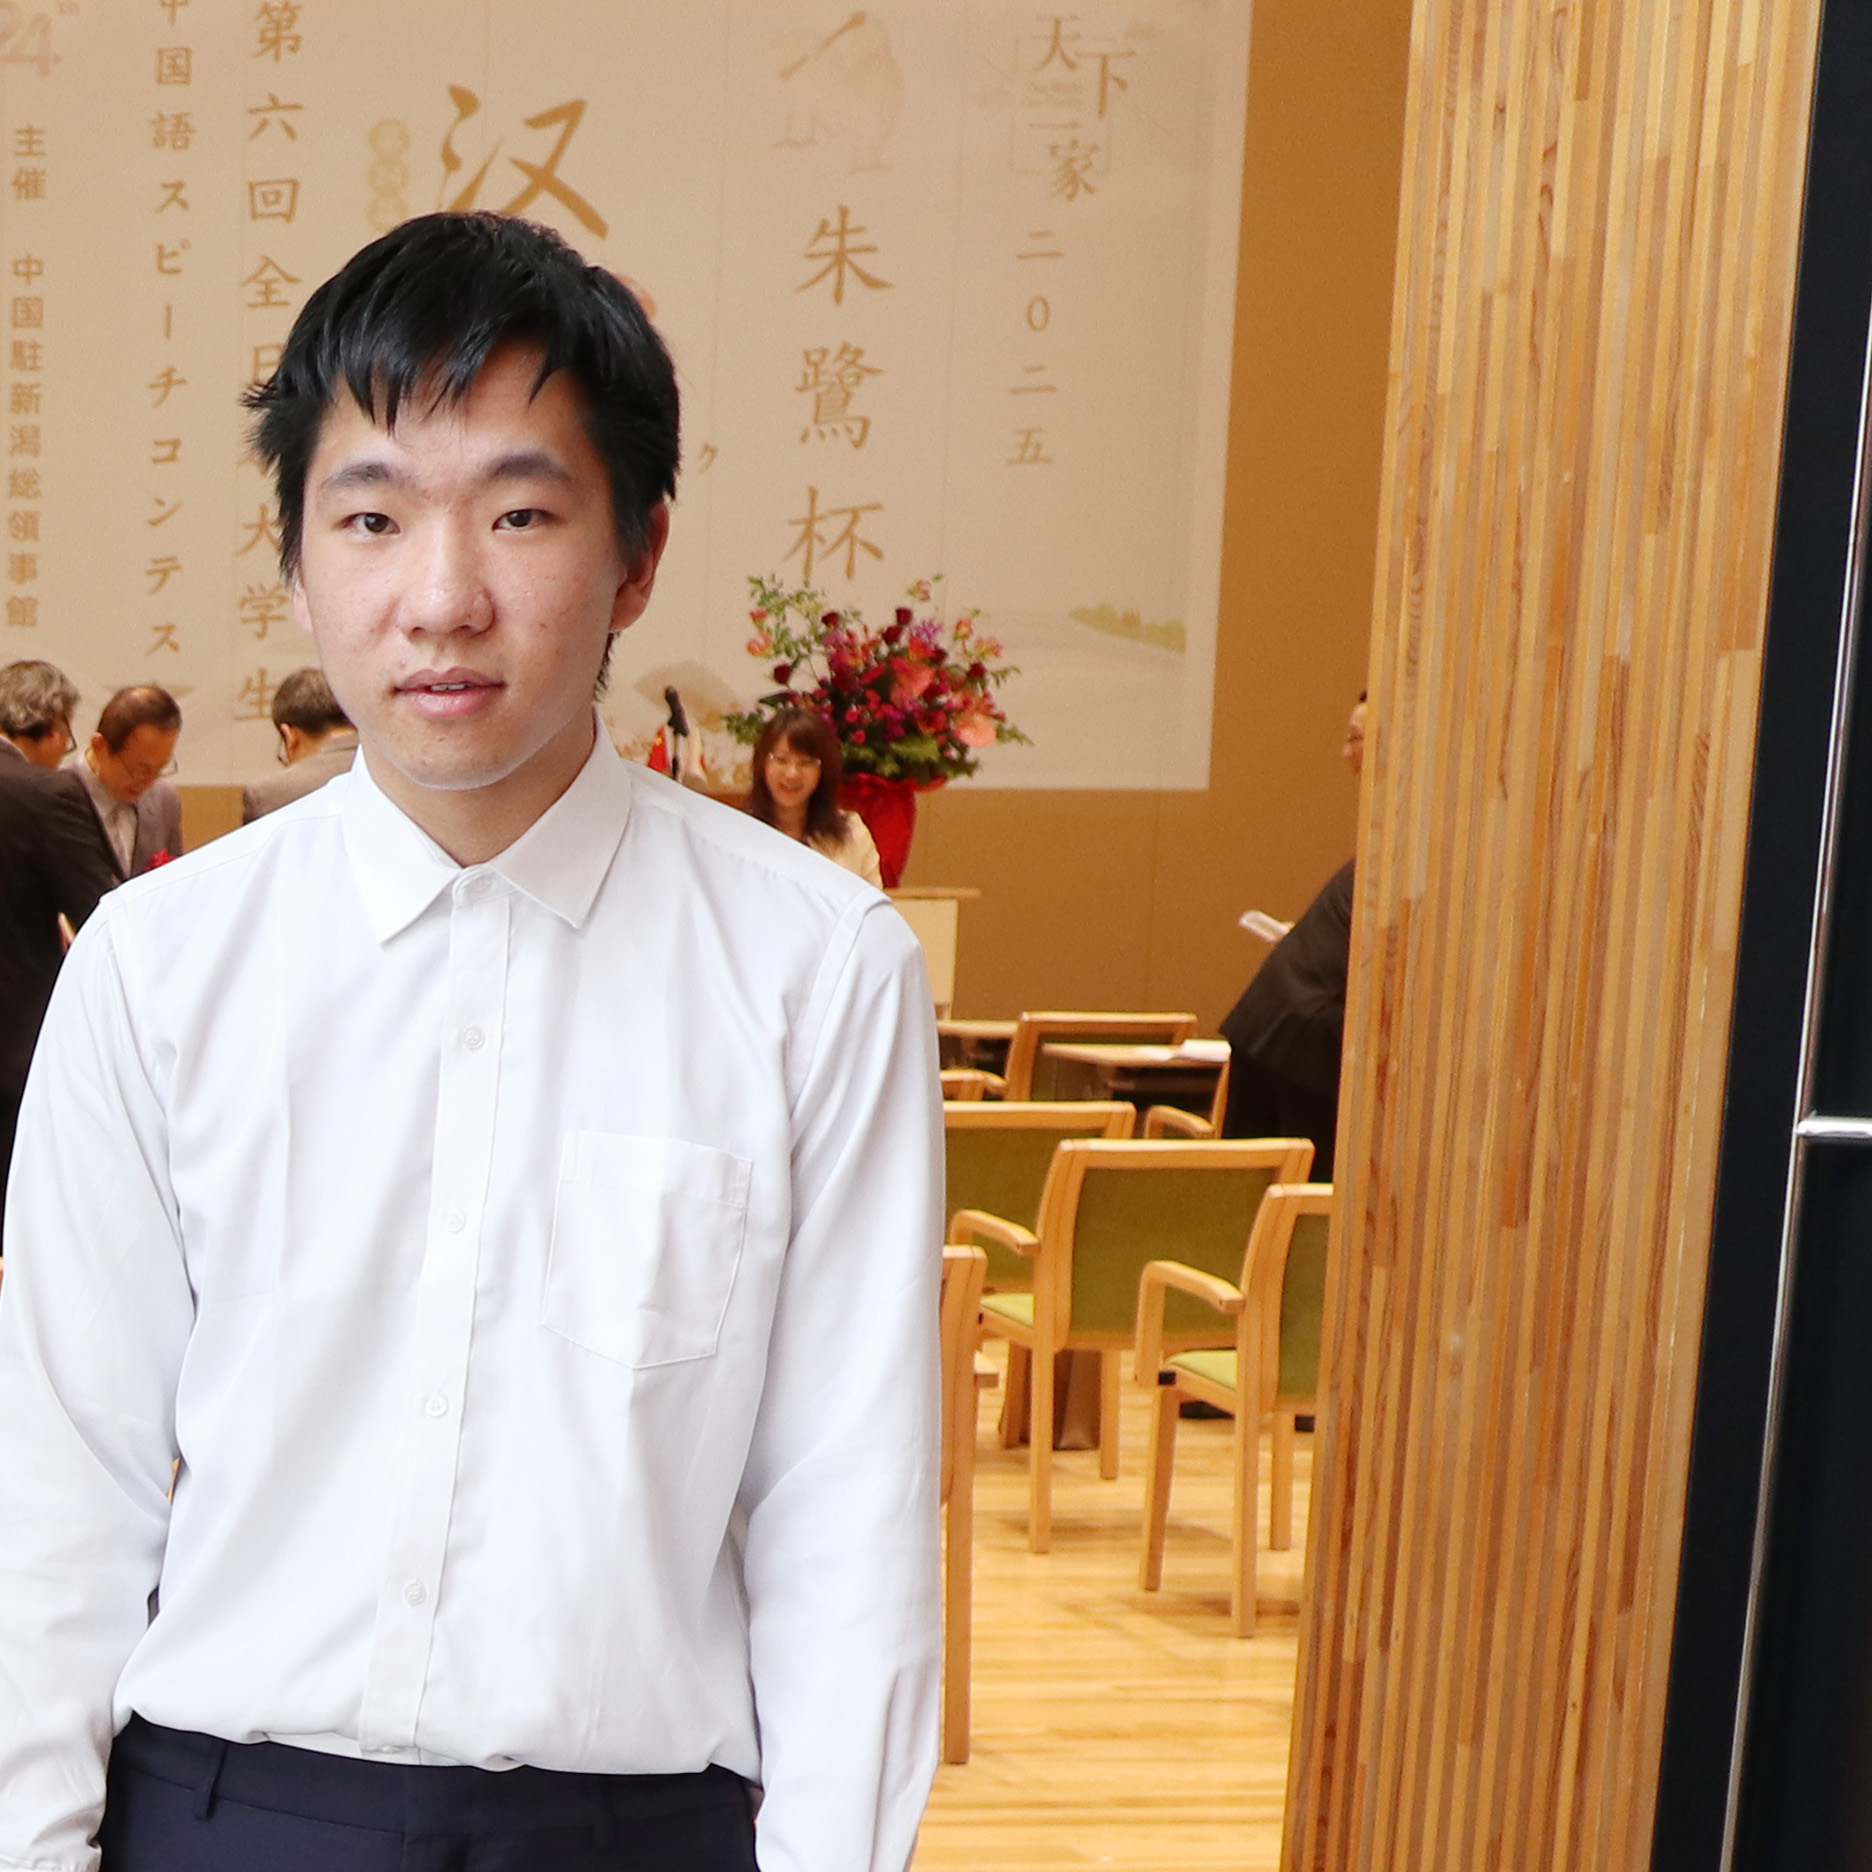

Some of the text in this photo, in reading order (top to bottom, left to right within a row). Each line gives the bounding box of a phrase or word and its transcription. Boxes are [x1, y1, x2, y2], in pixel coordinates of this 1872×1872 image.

[6, 123, 48, 629] 主催 中国駐新潟総領事館
[233, 0, 304, 723] 第六回全日大学生
[782, 203, 894, 582] 朱鷺杯
